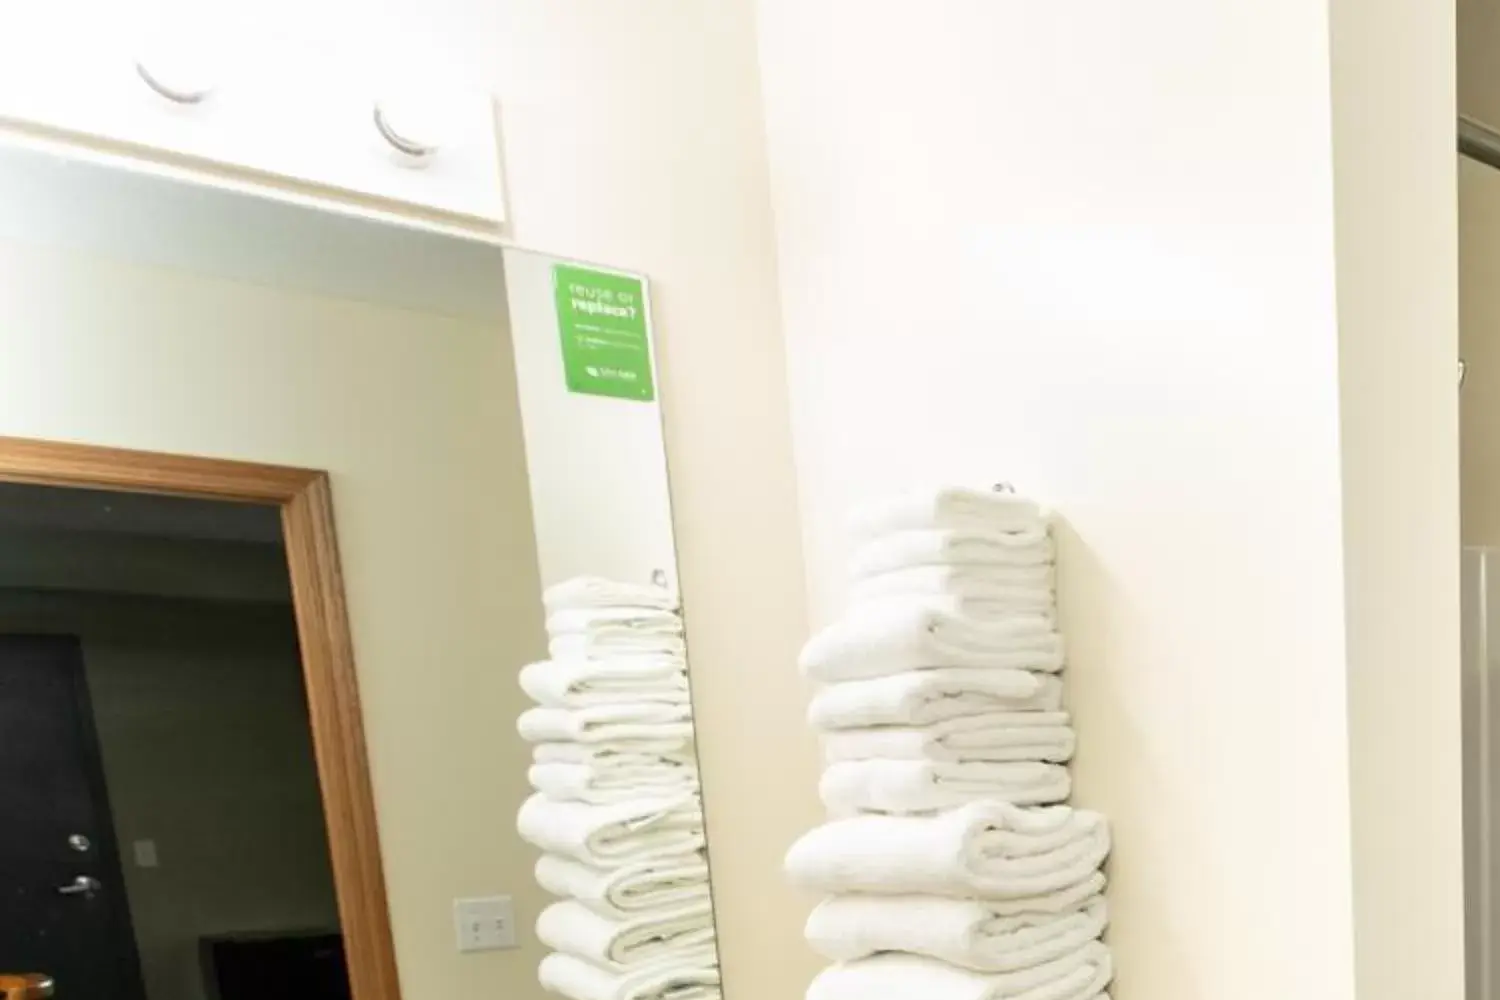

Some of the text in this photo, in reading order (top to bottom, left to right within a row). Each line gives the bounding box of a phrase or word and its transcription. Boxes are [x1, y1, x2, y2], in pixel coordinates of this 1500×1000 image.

[569, 284, 634, 304] reuse or
[571, 298, 636, 319] replace?
